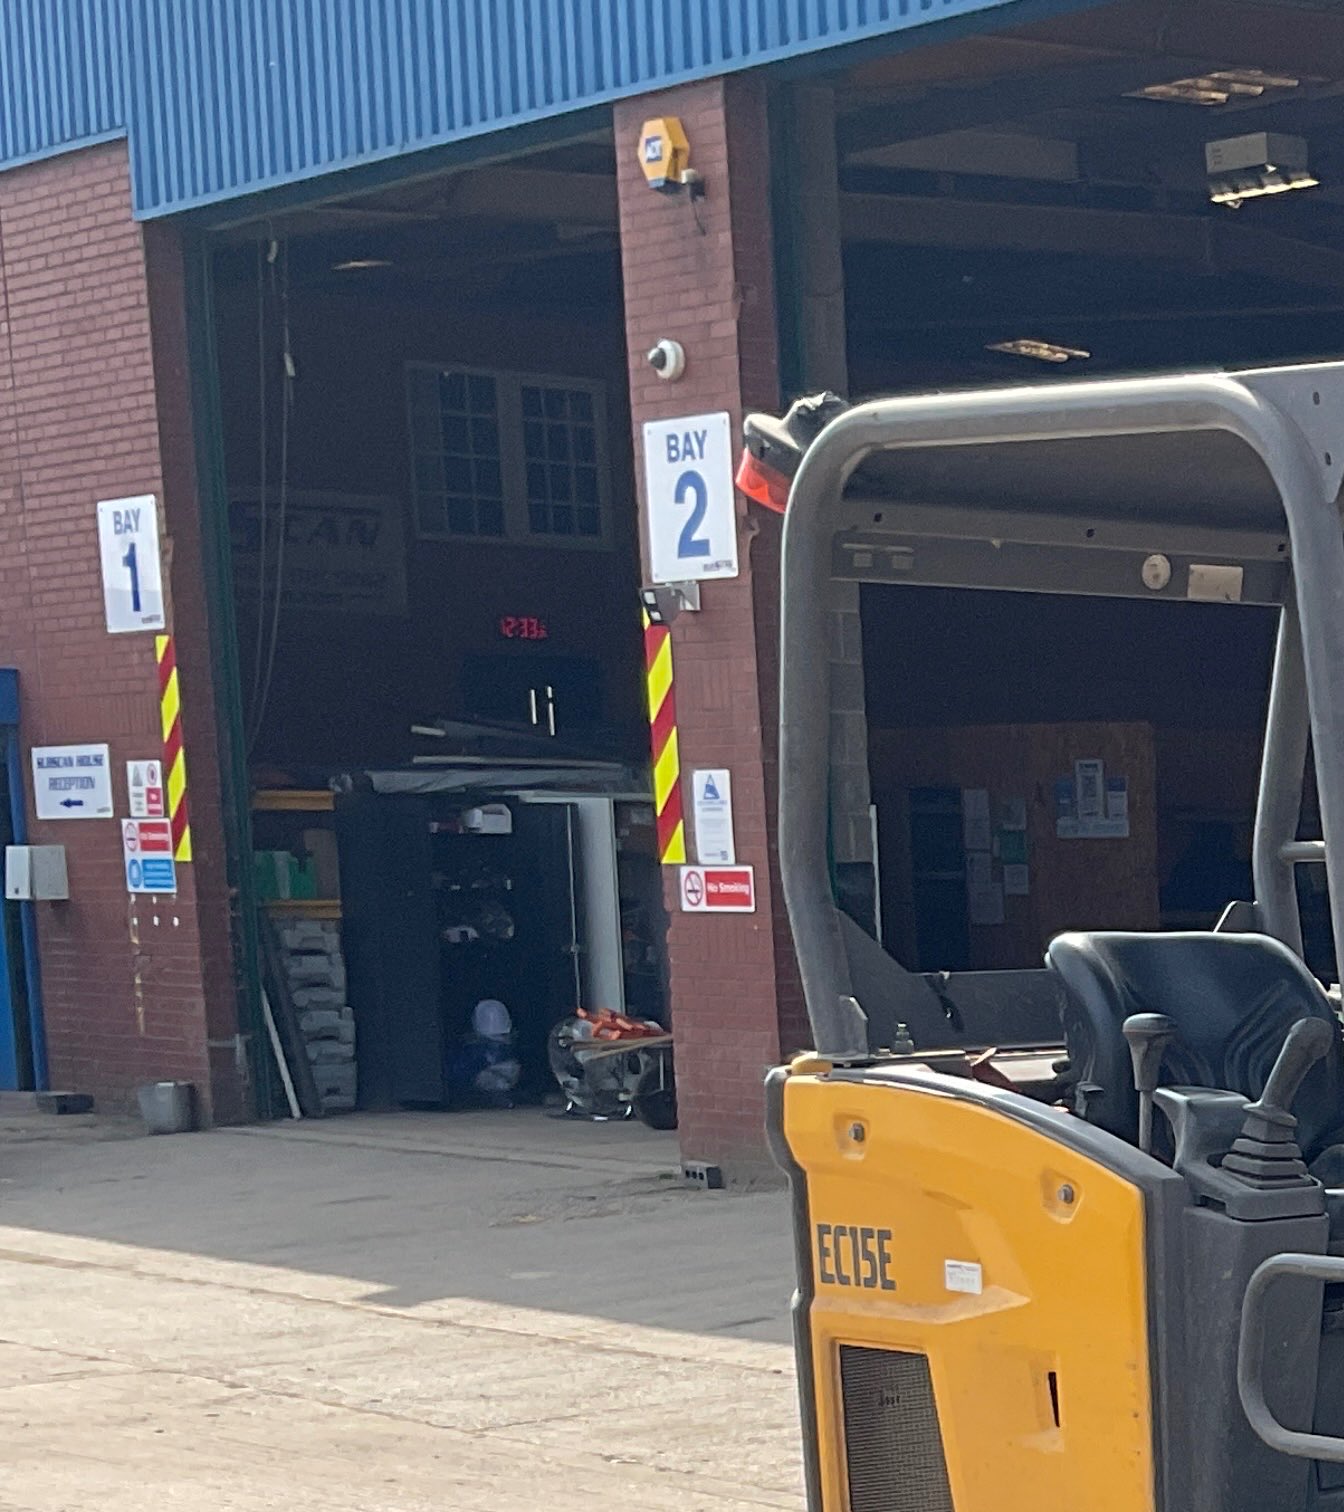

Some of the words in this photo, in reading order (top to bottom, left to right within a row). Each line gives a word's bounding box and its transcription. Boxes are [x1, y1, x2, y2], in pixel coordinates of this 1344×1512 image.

[666, 430, 708, 463] BAY
[112, 508, 141, 535] BAY
[673, 469, 711, 559] 2
[122, 542, 141, 612] 1
[48, 776, 96, 791] RECEPTION
[706, 882, 718, 893] No
[718, 881, 750, 895] Smoking
[816, 1223, 897, 1291] EC15E
